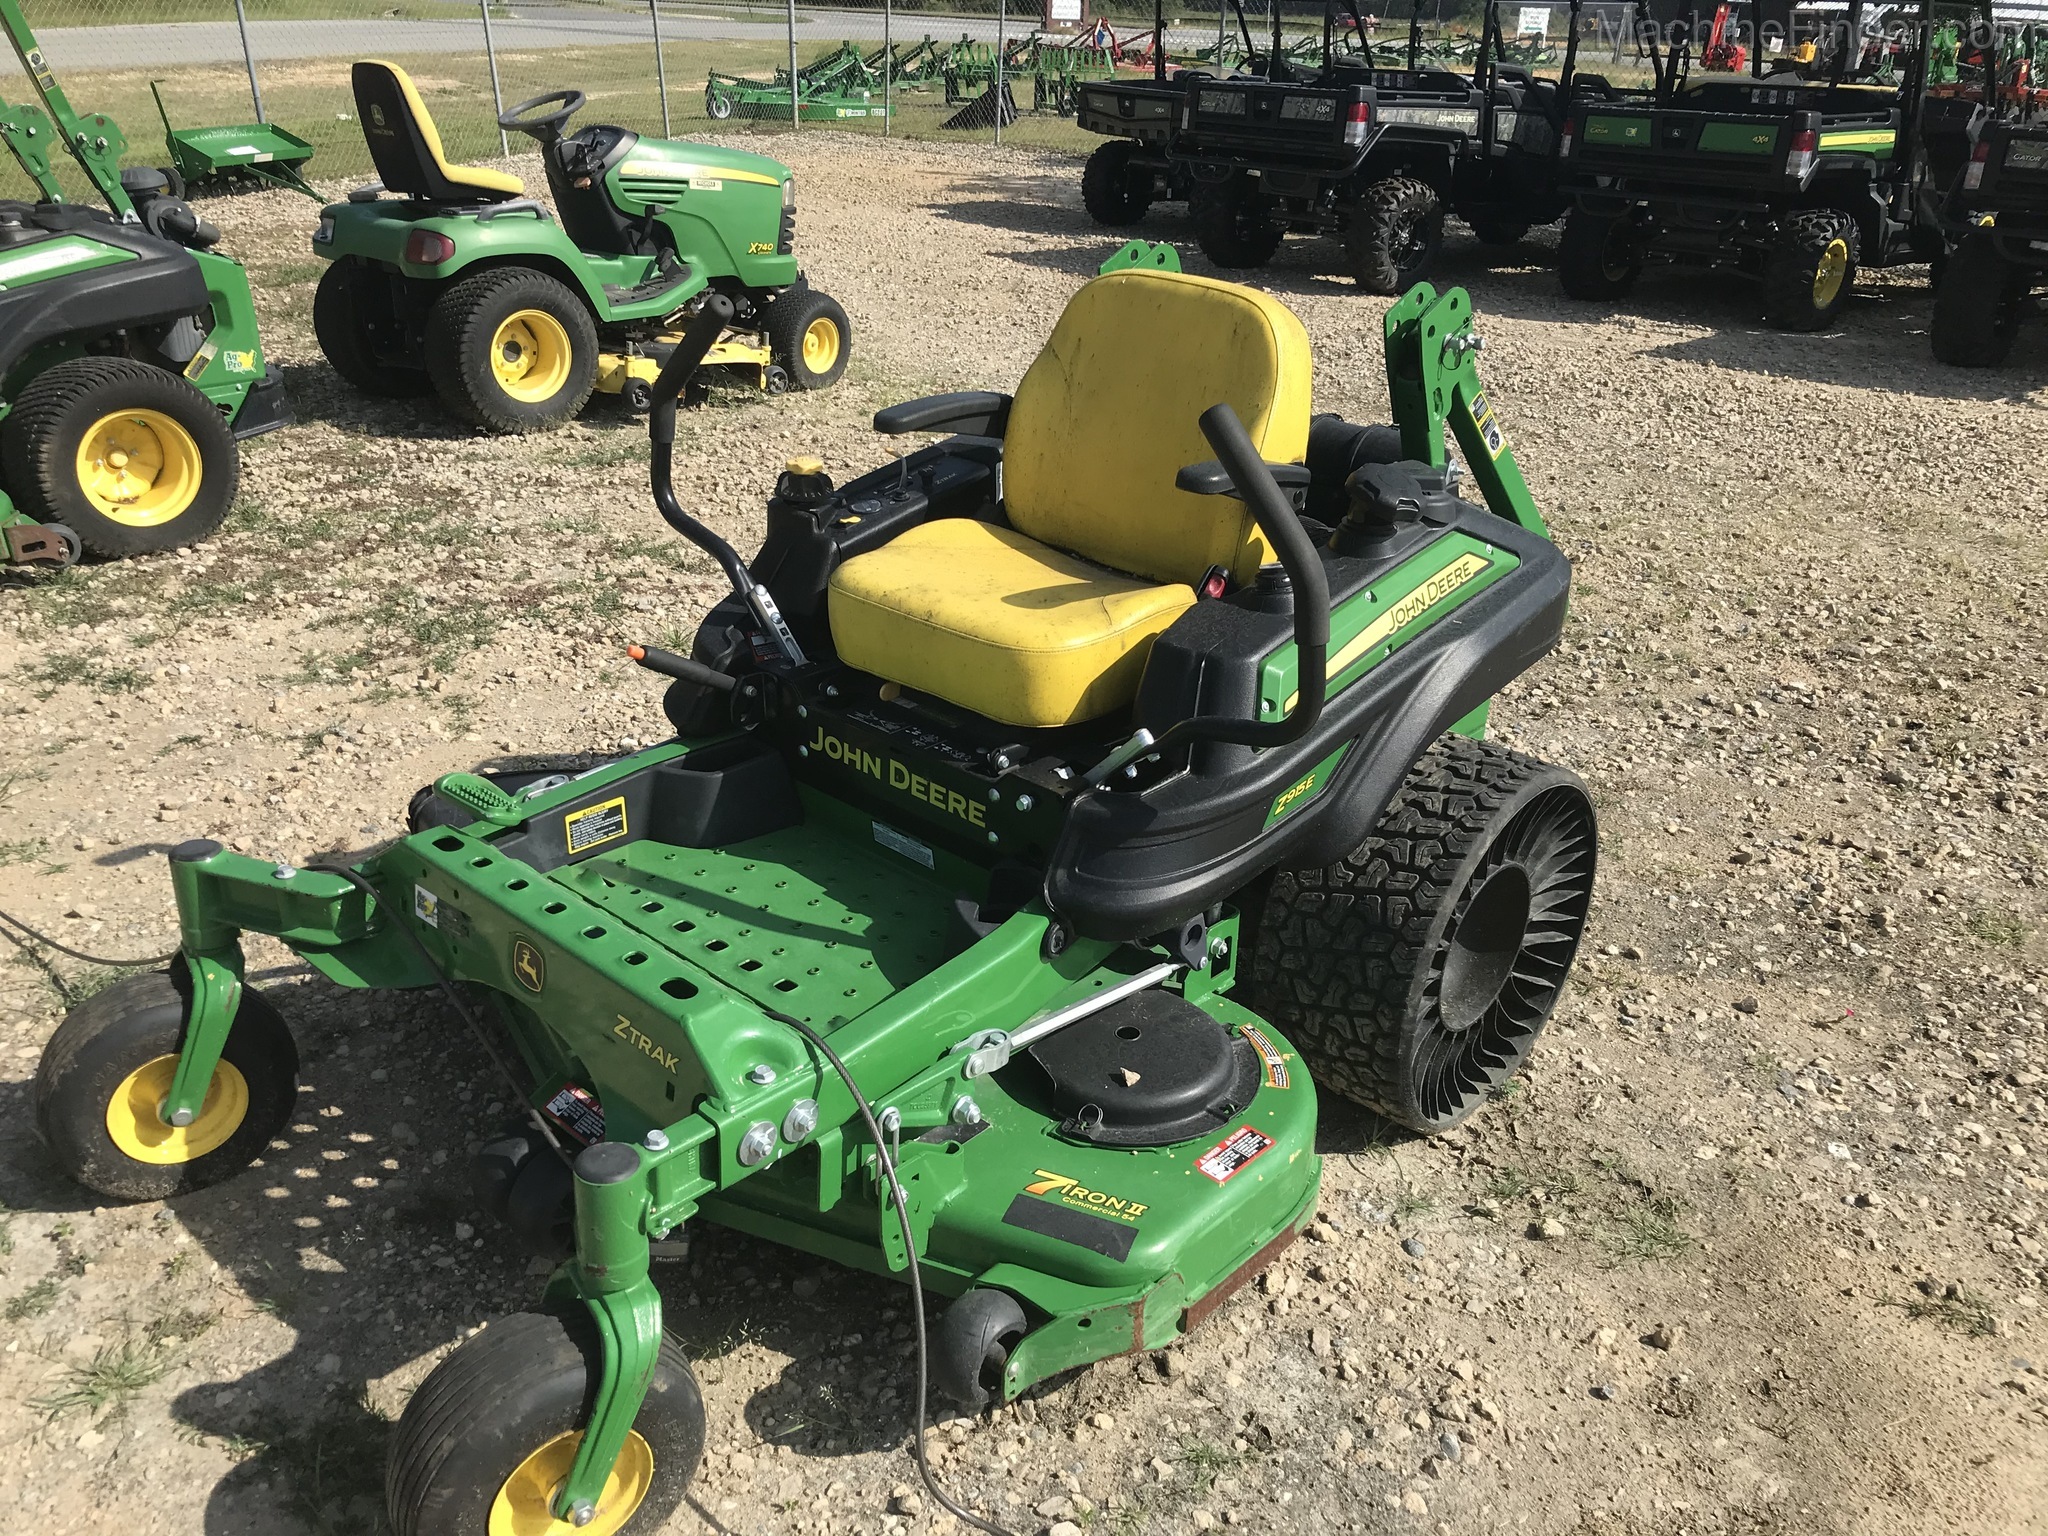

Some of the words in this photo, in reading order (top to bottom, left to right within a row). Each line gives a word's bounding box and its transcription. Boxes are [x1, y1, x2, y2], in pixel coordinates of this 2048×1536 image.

[1316, 105, 1330, 114] 4X4
[1437, 114, 1454, 123] JOHN
[1454, 114, 1476, 123] DEERE
[1752, 135, 1769, 144] 4X4
[746, 242, 774, 254] X740
[227, 361, 243, 369] Pro
[1388, 592, 1427, 632] JOHN
[1426, 561, 1472, 603] DEERE
[809, 726, 882, 780] JOHN
[889, 758, 987, 829] DEERE
[1274, 773, 1316, 816] Z915E
[613, 1013, 680, 1075] ZTRAK
[1062, 1196, 1121, 1217] Commercial
[1121, 1213, 1136, 1222] 54
